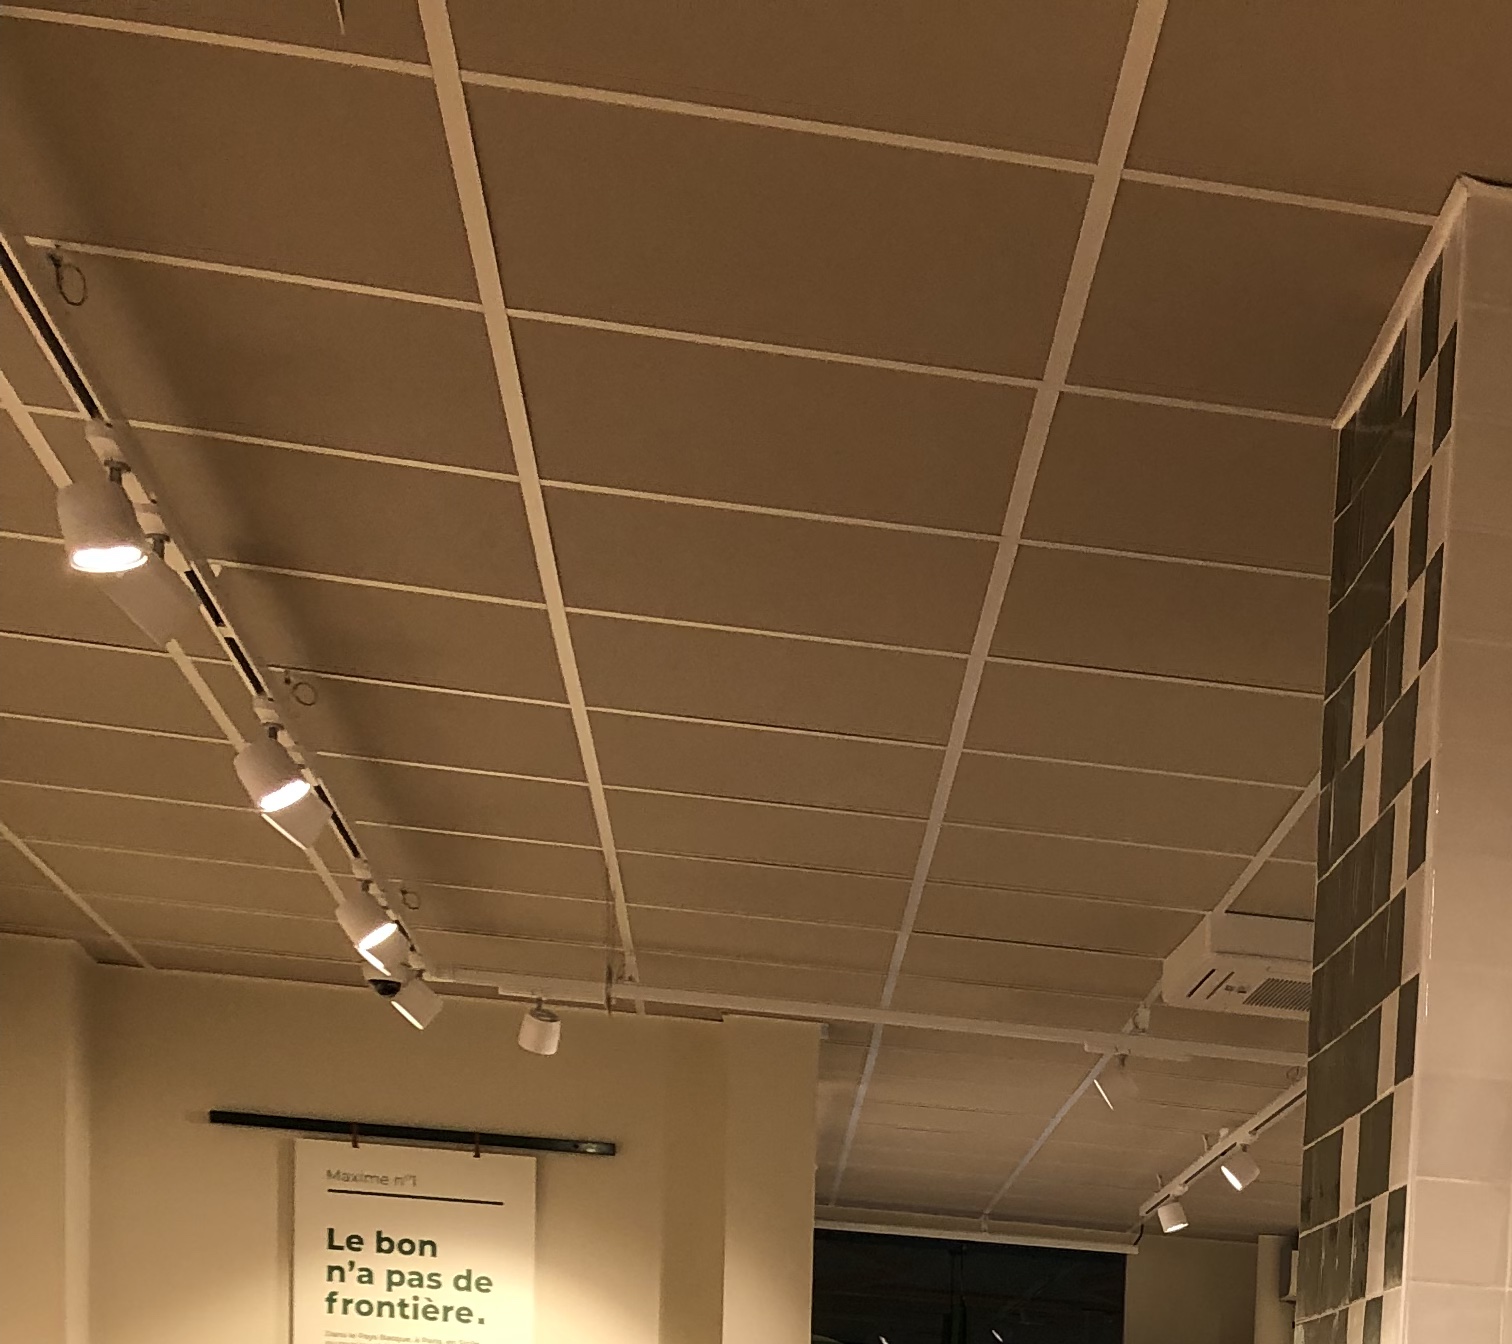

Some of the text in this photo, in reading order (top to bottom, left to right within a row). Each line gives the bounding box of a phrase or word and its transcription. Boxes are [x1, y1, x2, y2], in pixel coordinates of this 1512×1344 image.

[326, 1169, 390, 1186] Maxime
[327, 1227, 438, 1258] Le bon
[326, 1261, 493, 1294] n'a pas de
[325, 1290, 486, 1325] frontière.
